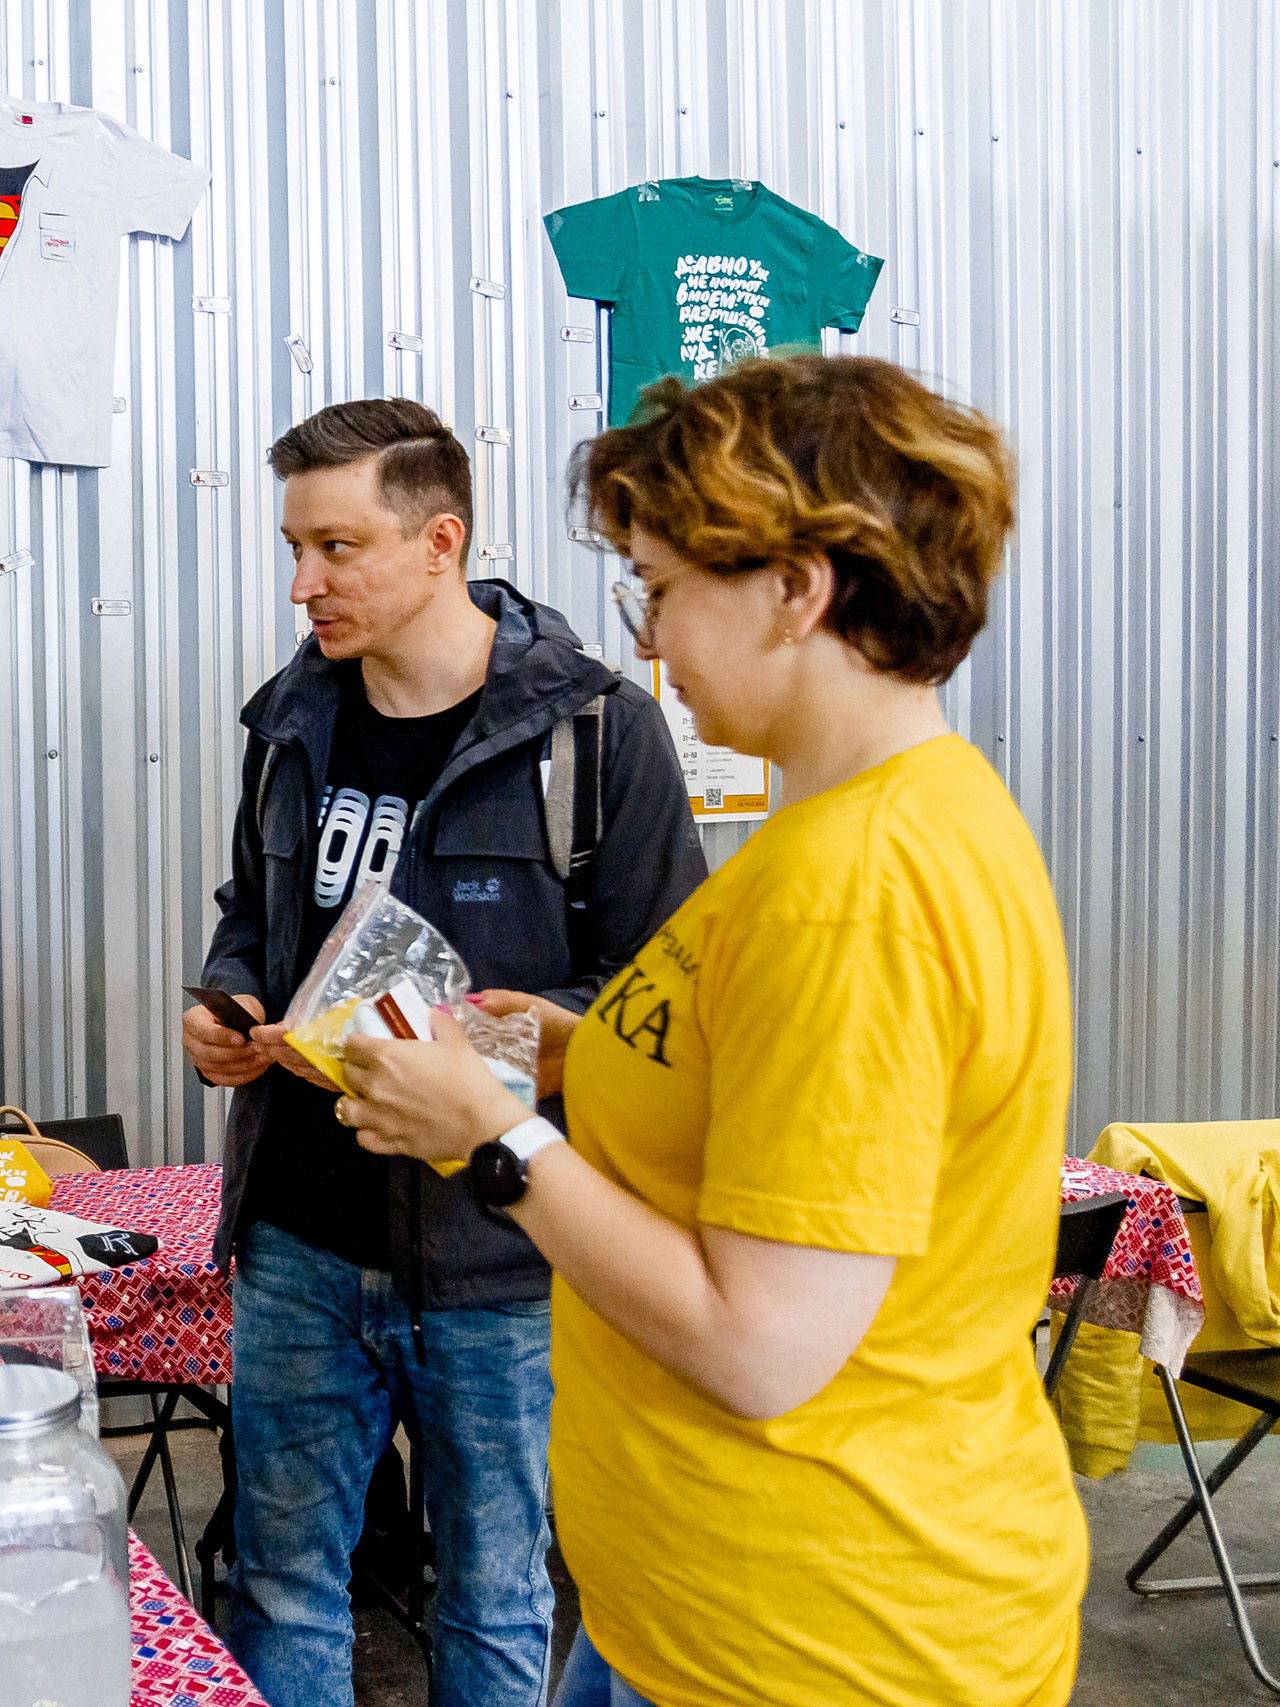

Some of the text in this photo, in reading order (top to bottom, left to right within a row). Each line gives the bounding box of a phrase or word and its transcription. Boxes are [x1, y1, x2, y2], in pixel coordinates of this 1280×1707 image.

[674, 254, 770, 282] ДАВНО УЖ
[687, 274, 709, 290] НЕ
[688, 290, 737, 309] МОЕМ
